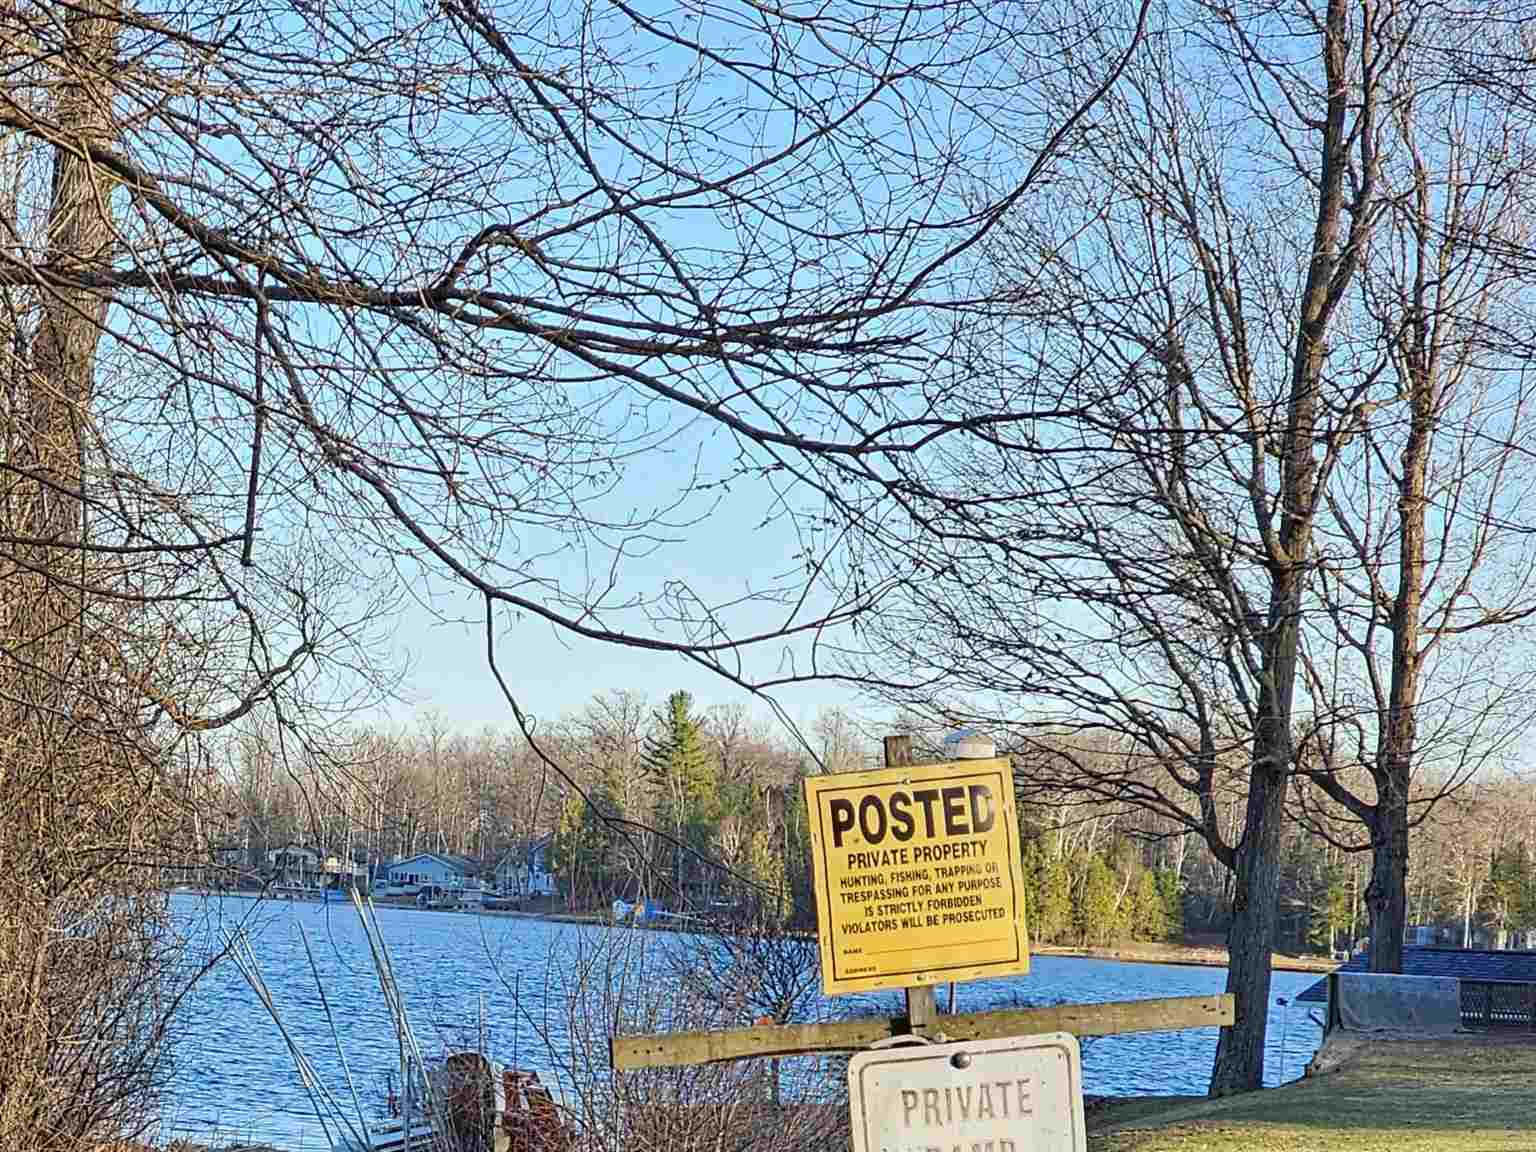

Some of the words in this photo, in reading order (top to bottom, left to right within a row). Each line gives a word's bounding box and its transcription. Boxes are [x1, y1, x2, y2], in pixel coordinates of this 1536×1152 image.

[830, 785, 995, 848] POSTED
[848, 848, 908, 869] PRIVATE
[914, 840, 988, 862] PROPERTY
[936, 864, 981, 879] TRAPPING
[985, 862, 999, 874] OR
[840, 885, 909, 904] TRESPASSING
[913, 884, 932, 896] FOR
[935, 882, 954, 894] ANY
[958, 877, 1002, 890] PURPOSE
[864, 907, 874, 917] IS
[877, 901, 924, 916] STRICTLY
[927, 895, 982, 911] FORBIDDEN
[842, 918, 898, 935] VIOLATORS
[902, 916, 923, 928] WILL
[926, 914, 939, 926] BE
[943, 907, 1005, 924] PROSECUTED
[901, 1078, 1033, 1126] PRIVATE
